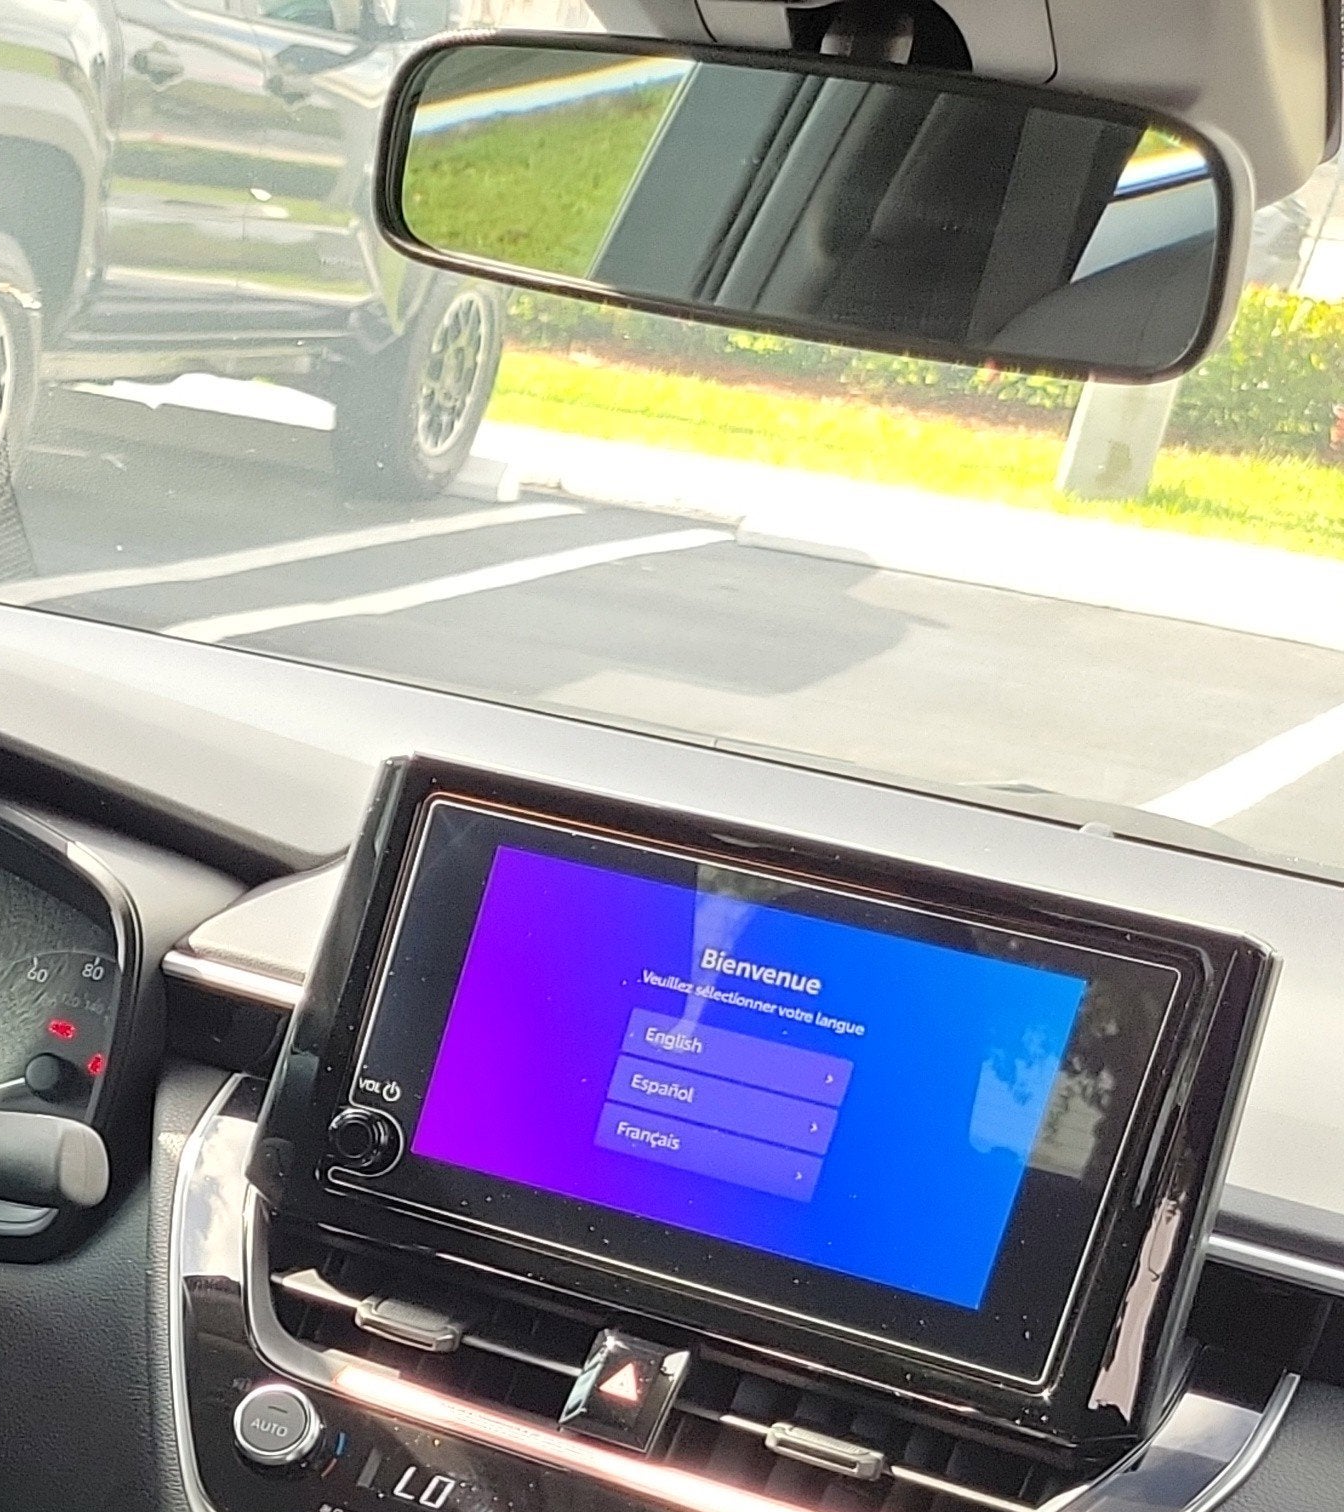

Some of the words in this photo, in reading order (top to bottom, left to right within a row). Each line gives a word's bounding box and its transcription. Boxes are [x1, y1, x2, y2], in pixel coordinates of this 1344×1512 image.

[27, 966, 48, 982] 60
[81, 963, 104, 980] 80
[700, 948, 823, 995] Bienvenue
[642, 969, 694, 994] Veuillez
[695, 983, 777, 1013] sélectionner
[778, 1005, 814, 1024] votre
[815, 1012, 866, 1036] langue
[644, 1027, 703, 1054] English
[359, 1077, 380, 1094] VOL
[630, 1073, 694, 1103] Español
[616, 1121, 681, 1150] Français
[251, 1418, 288, 1437] AUTO
[393, 1466, 455, 1508] LO
